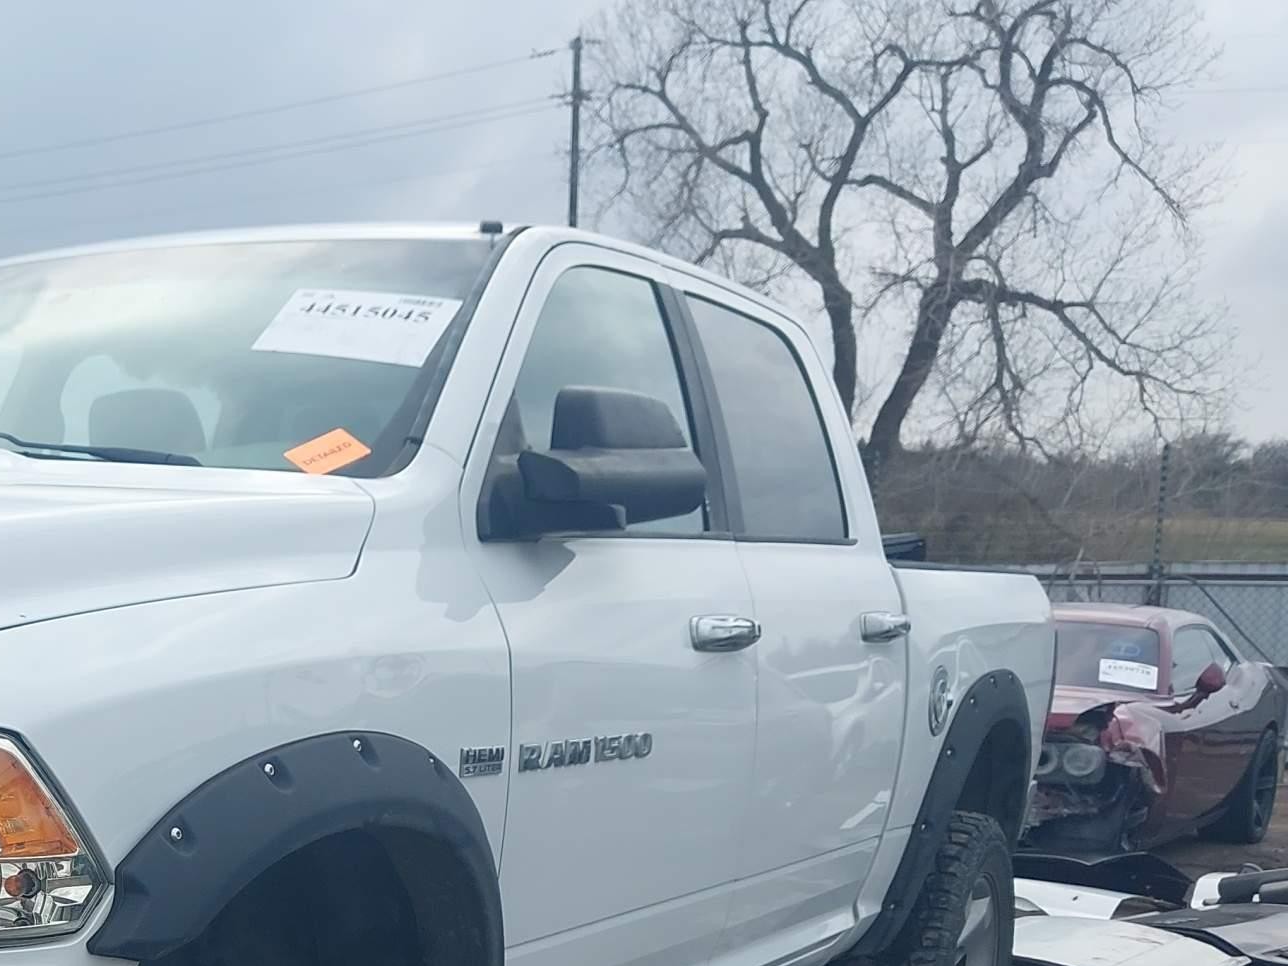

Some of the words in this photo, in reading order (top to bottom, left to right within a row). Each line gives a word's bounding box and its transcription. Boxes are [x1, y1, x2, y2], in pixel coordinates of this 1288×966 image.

[299, 302, 433, 323] 44515045
[464, 747, 505, 764] HEMI
[518, 739, 592, 772] RAM
[593, 733, 652, 763] 1500
